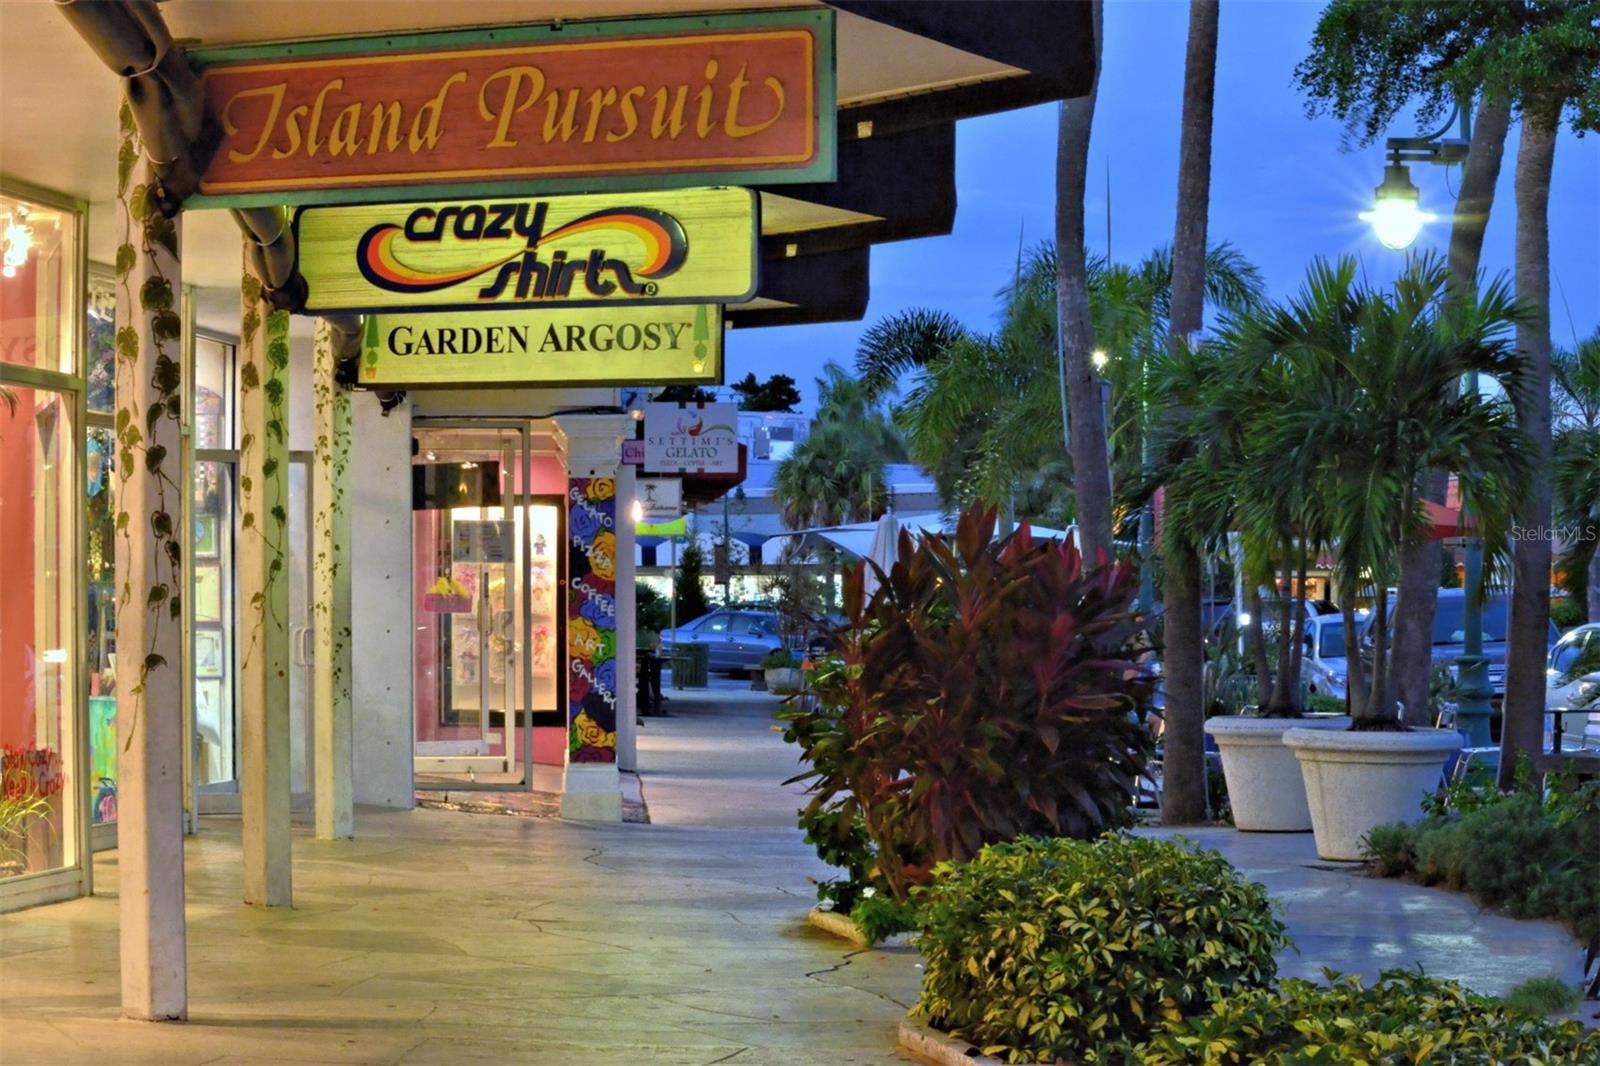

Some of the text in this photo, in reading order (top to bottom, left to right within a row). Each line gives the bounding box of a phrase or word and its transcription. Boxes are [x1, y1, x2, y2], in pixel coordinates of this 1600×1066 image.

[225, 59, 786, 163] Island Pursuit
[404, 201, 550, 248] crazy
[387, 322, 687, 357] GARDEN ARGOSY
[665, 447, 718, 458] GELATO
[569, 487, 613, 527] GELATO
[573, 535, 612, 568] PIZZA
[571, 577, 615, 617] COFFEE
[574, 634, 606, 656] ART
[571, 658, 617, 711] GALLERY
